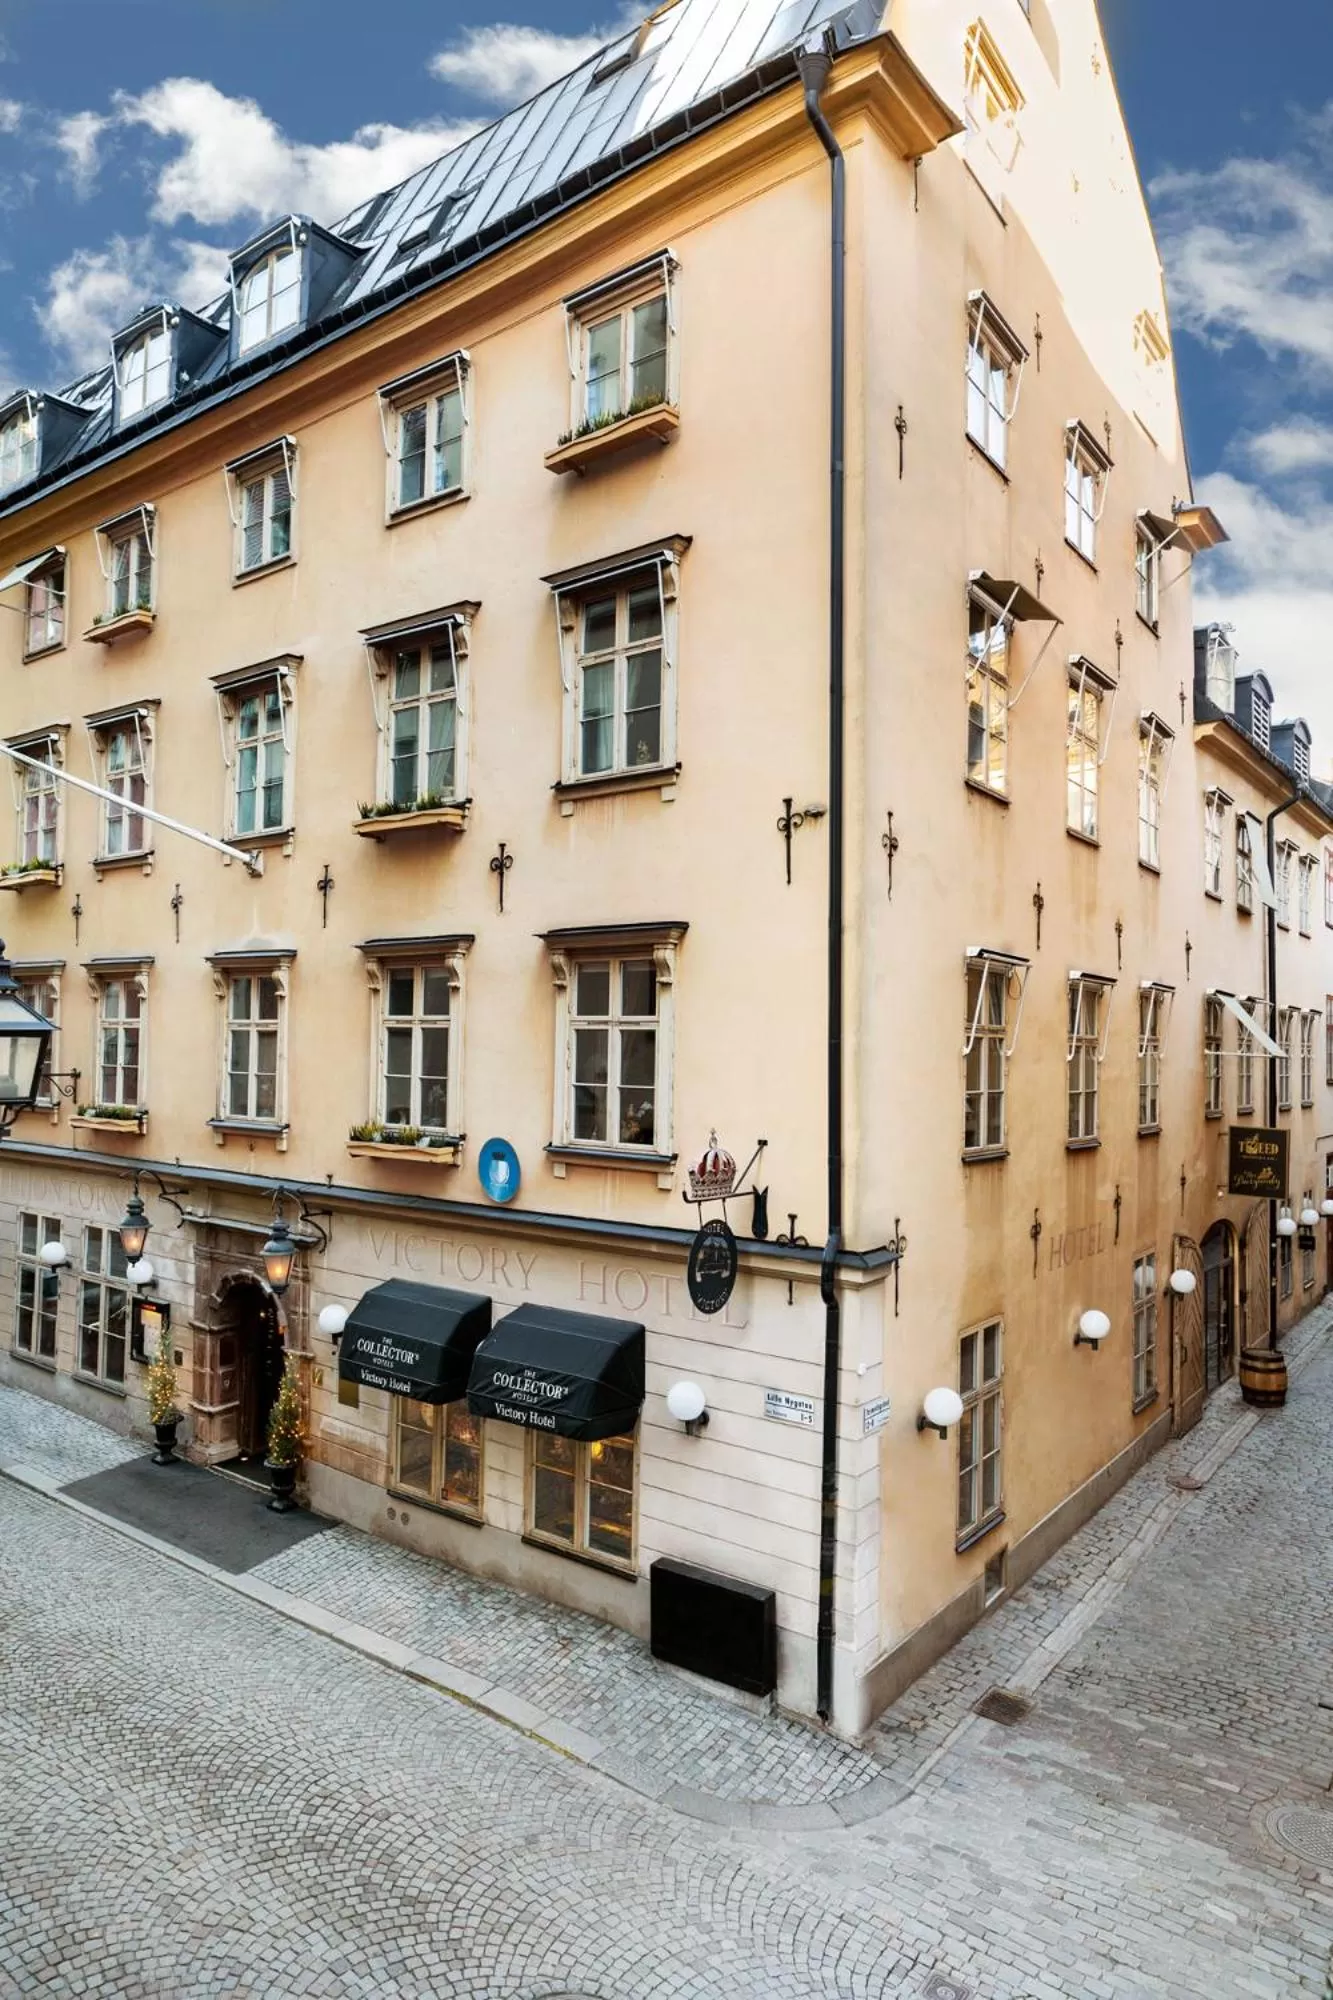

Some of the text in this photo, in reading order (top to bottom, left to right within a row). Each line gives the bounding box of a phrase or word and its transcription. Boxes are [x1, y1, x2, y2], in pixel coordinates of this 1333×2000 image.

[368, 1229, 539, 1290] VICTORY
[1048, 1221, 1105, 1272] HOTEL
[360, 1367, 412, 1393] Victory Hotel
[494, 1401, 556, 1429] Victory Hotel
